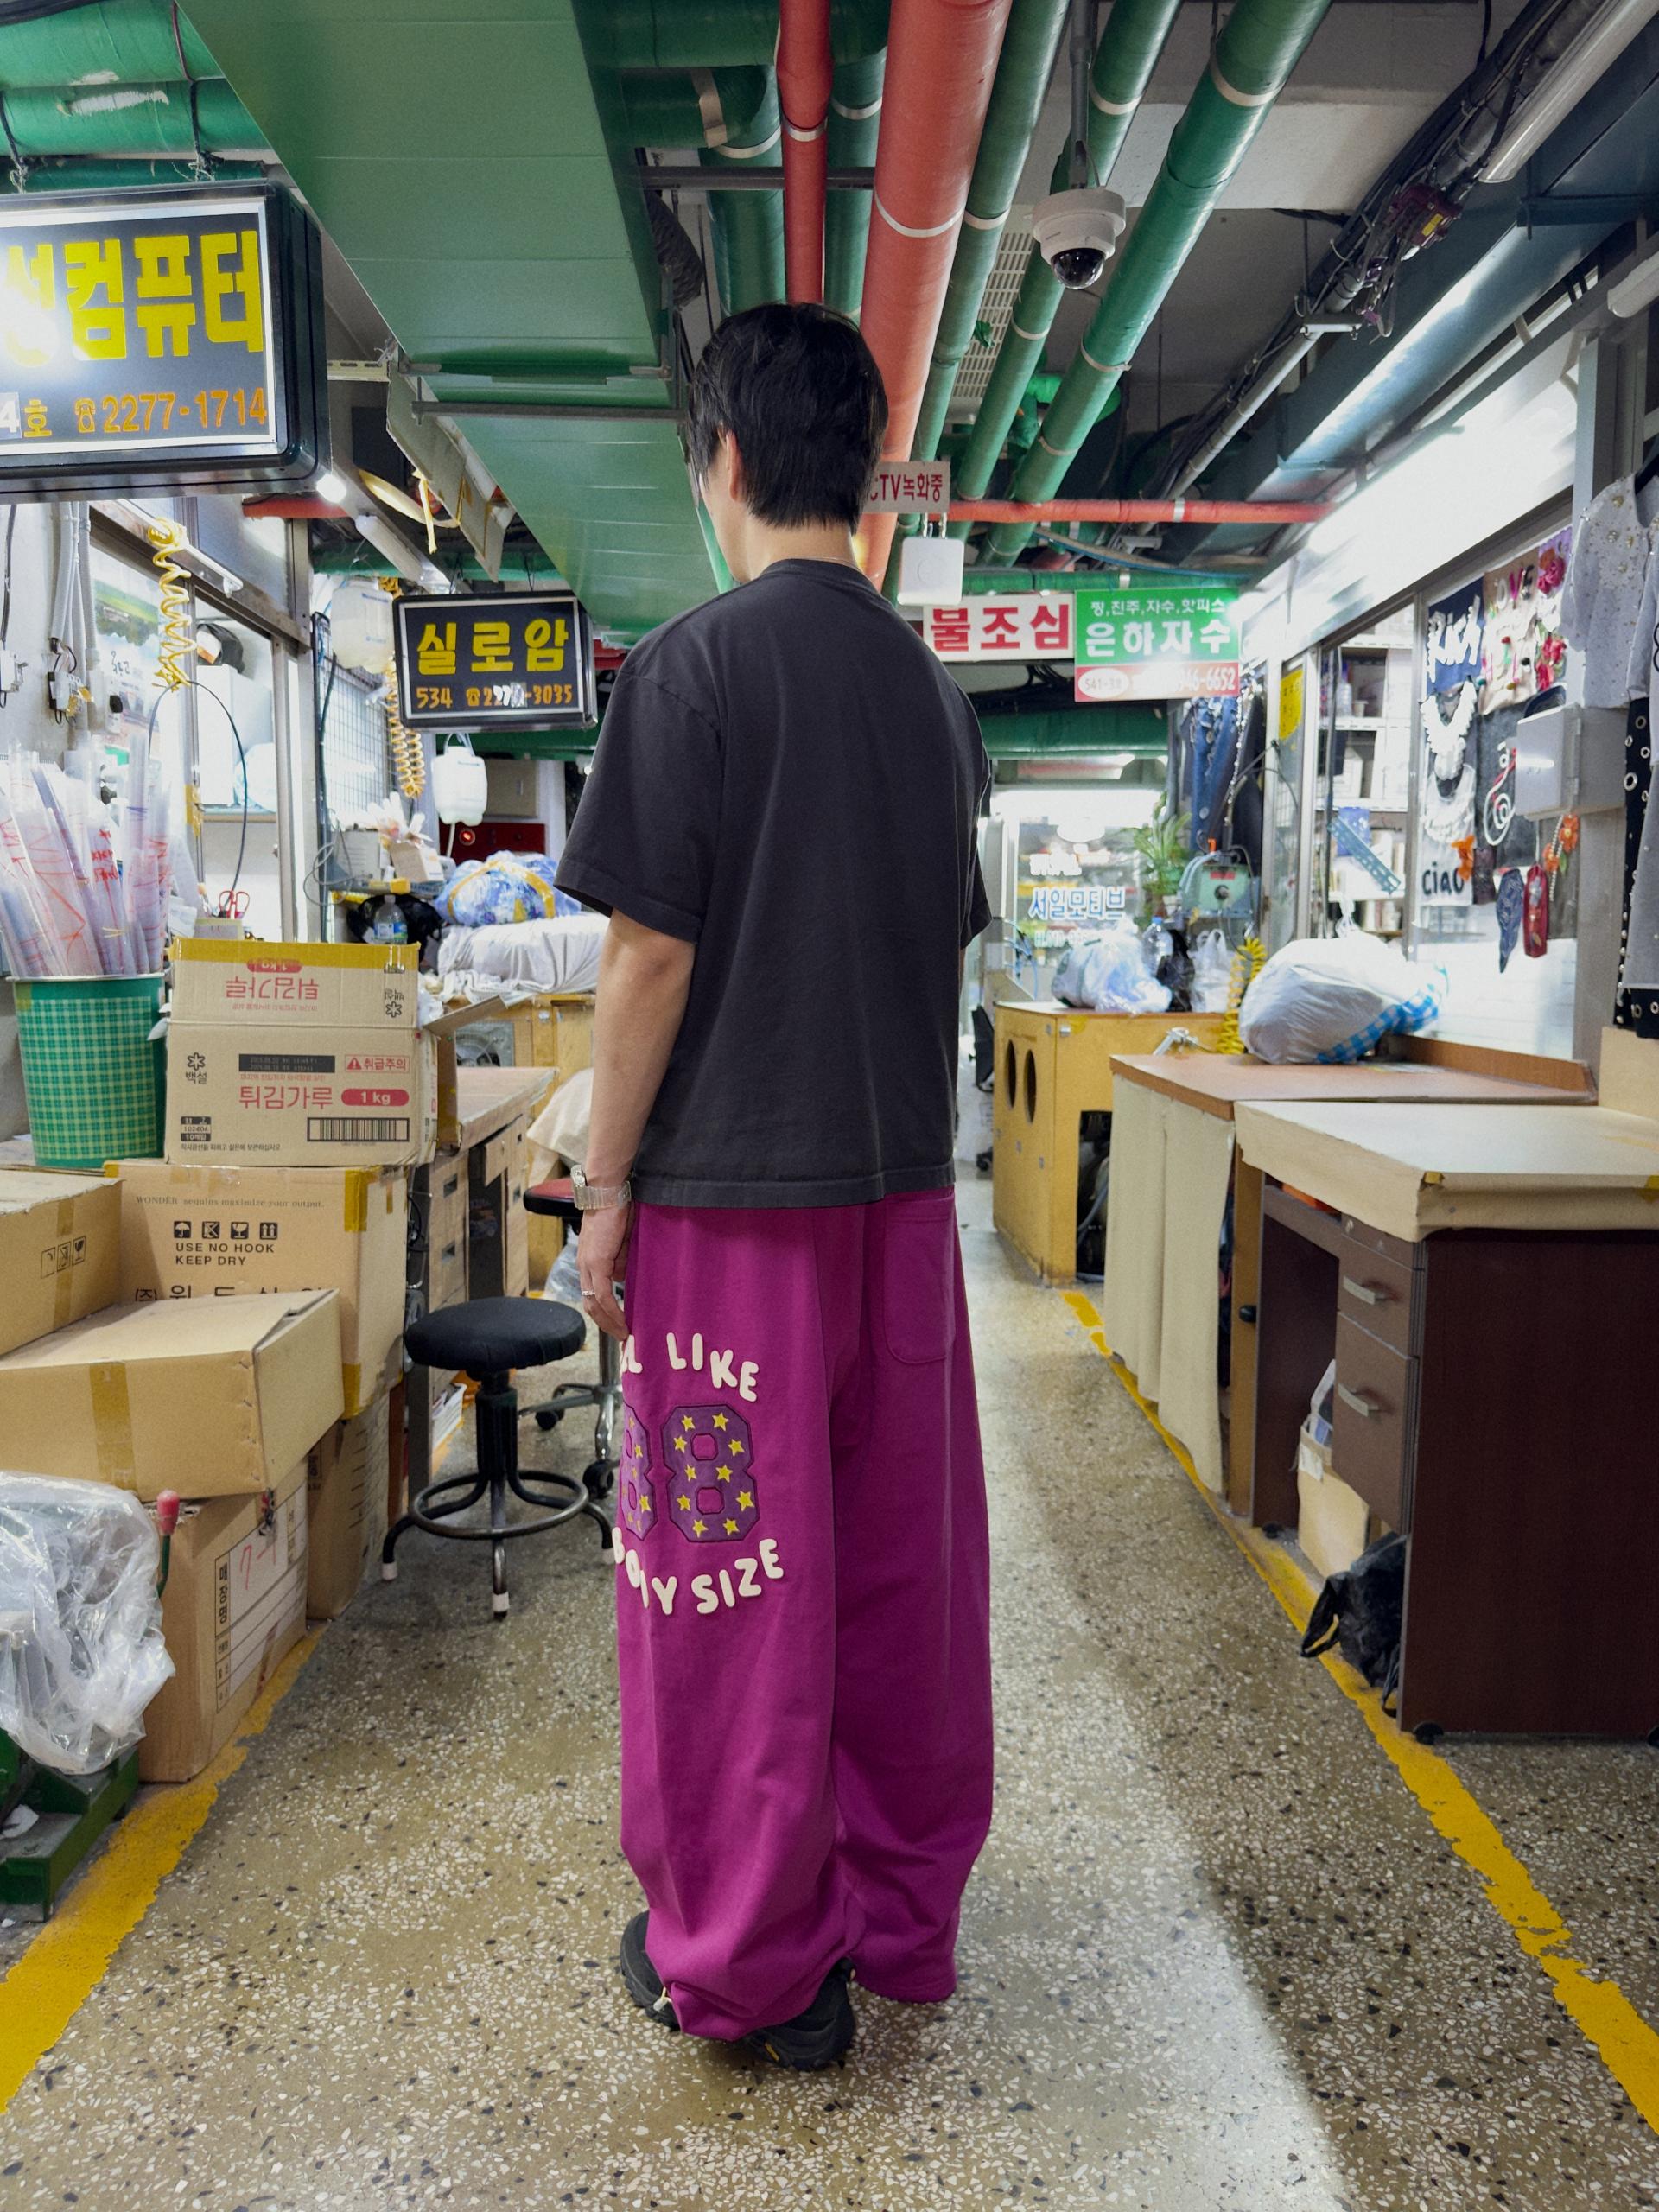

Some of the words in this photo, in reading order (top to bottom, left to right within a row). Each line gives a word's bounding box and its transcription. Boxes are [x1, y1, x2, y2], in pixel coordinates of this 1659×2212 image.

[102, 388, 267, 433] 2277-1714
[931, 603, 1069, 652] 불조심
[1085, 619, 1231, 657] 은하자수
[417, 617, 569, 676] 실로암
[416, 686, 453, 709] 534
[226, 976, 320, 1001] 튀김가루
[363, 1058, 407, 1071] 취급주의
[185, 1071, 207, 1084] 백설
[238, 1085, 334, 1110] 튀김가루
[372, 1090, 391, 1105] kg
[175, 1243, 203, 1252] USE
[209, 1243, 228, 1252] NO
[234, 1243, 275, 1253] HOOK
[175, 1255, 212, 1265] KEEP
[218, 1256, 246, 1265] DRY
[666, 1332, 760, 1402] LIKE
[691, 1538, 784, 1614] SIZE
